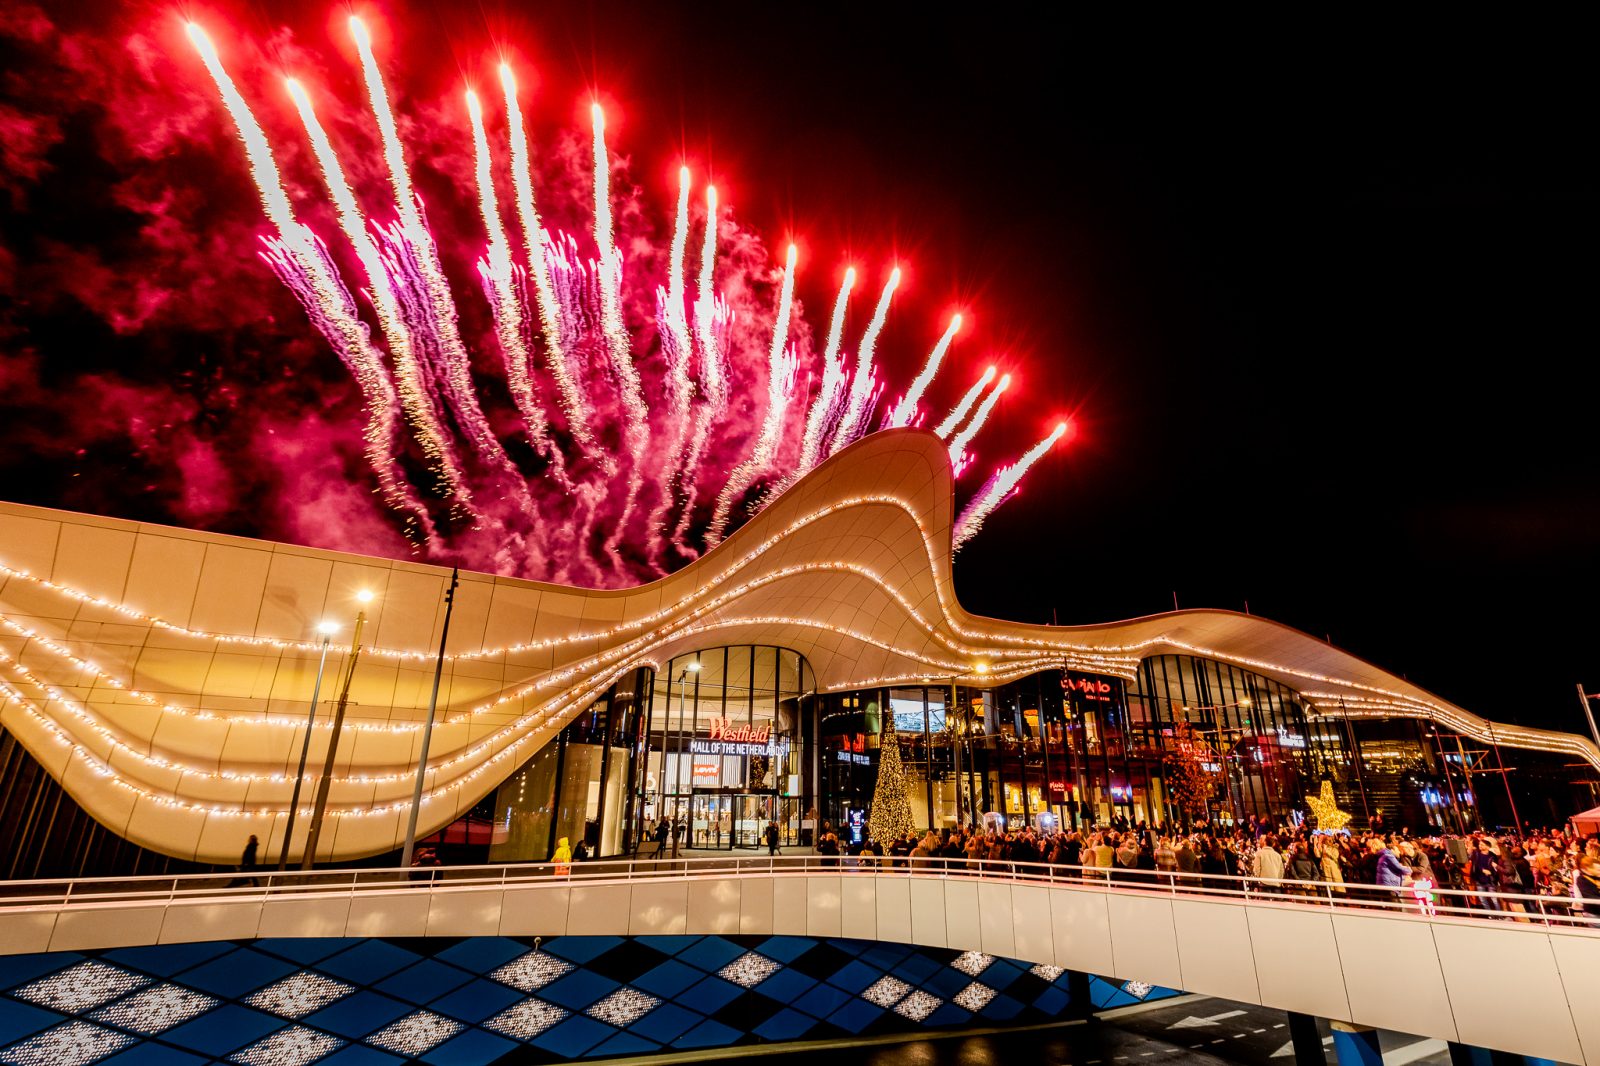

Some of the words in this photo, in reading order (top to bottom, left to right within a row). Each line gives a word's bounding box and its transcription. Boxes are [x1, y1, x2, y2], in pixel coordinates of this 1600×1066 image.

[709, 716, 770, 742] Westfield
[690, 741, 710, 753] MALL
[711, 743, 721, 754] OF
[721, 743, 735, 755] THE
